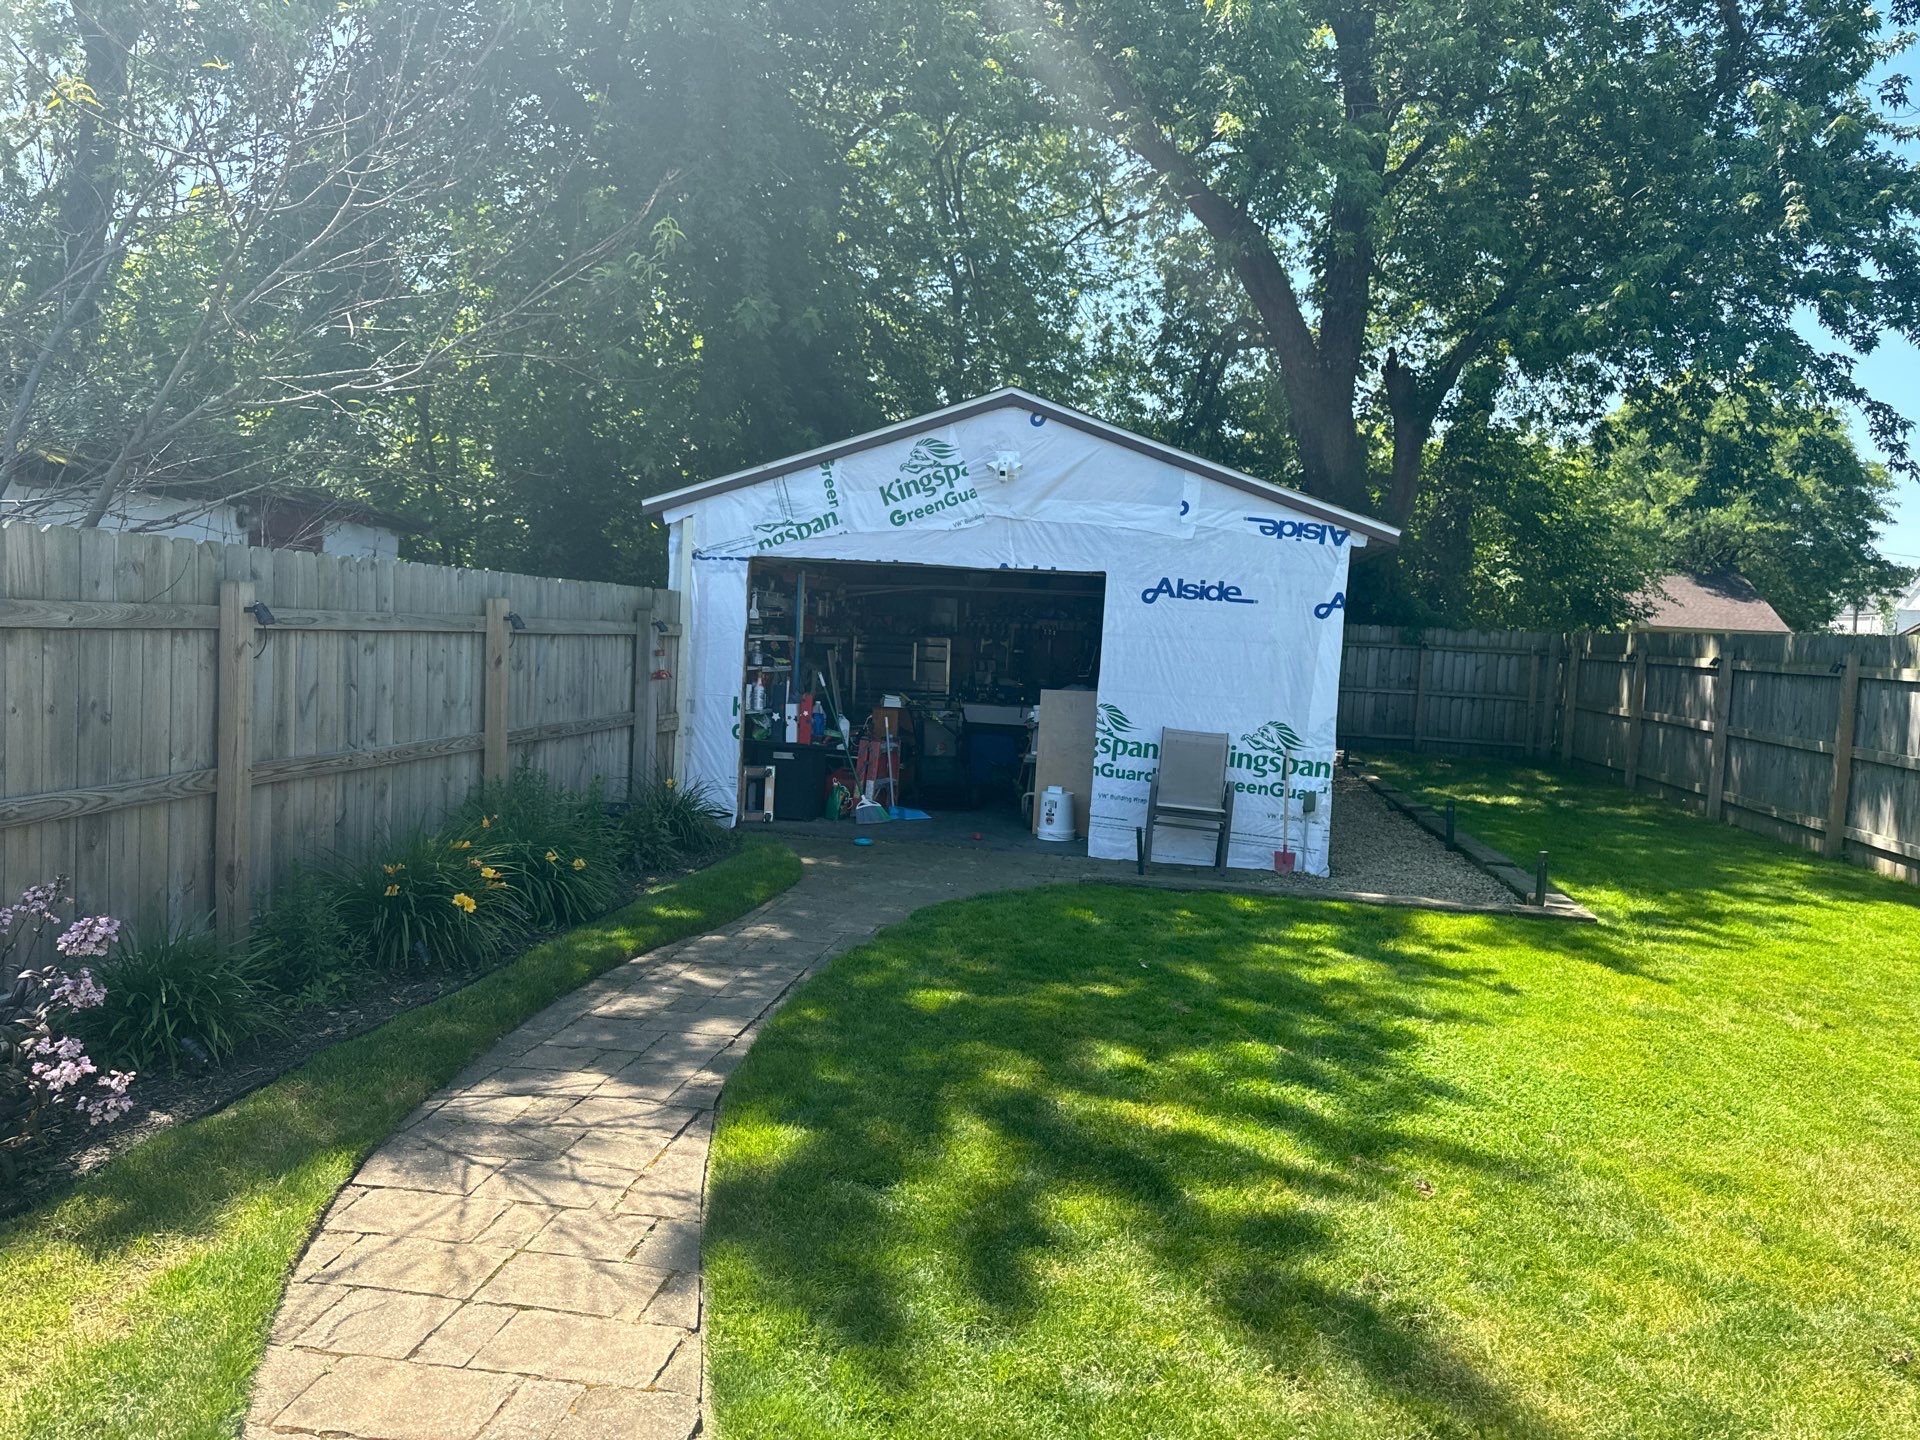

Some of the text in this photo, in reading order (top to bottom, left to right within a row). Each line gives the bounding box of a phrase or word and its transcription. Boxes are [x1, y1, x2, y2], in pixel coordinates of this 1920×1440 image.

[1246, 516, 1350, 546] Alside
[1141, 577, 1256, 604] Alside
[1227, 745, 1331, 780] ingspan
